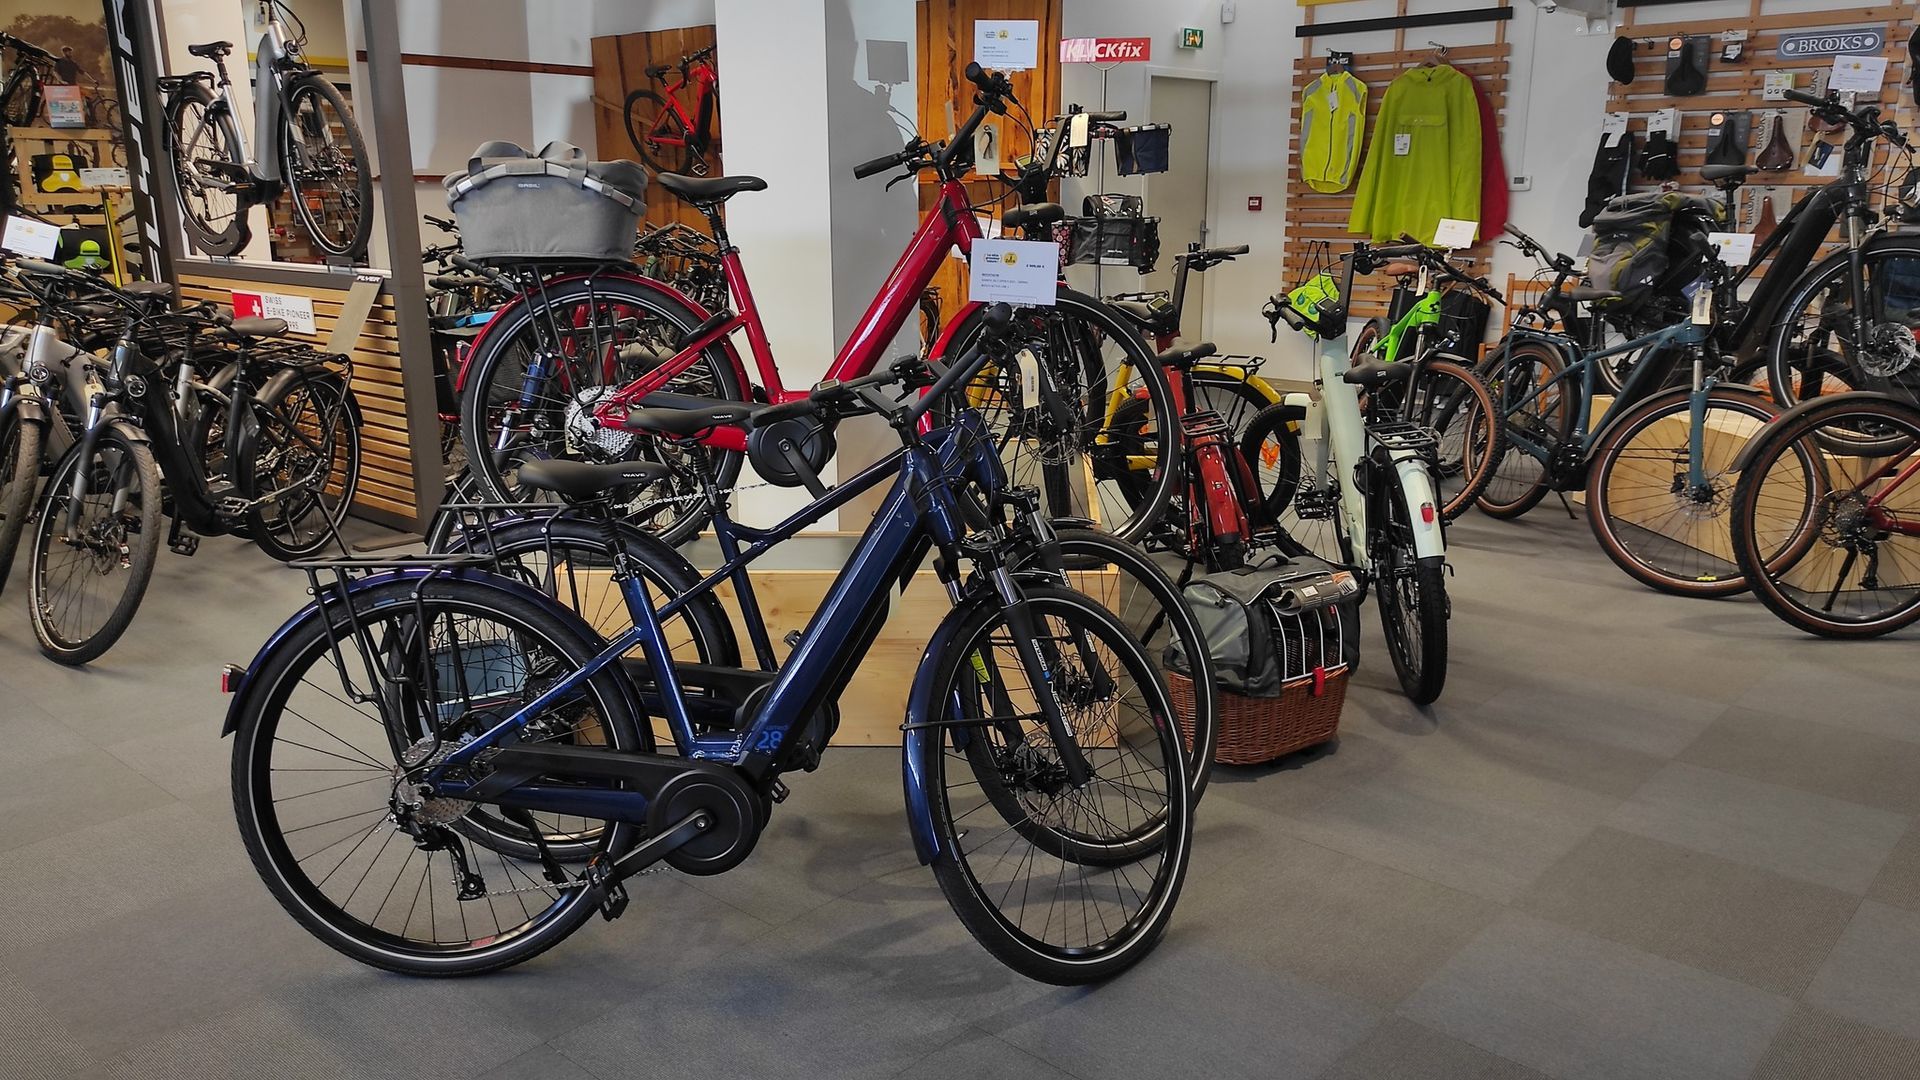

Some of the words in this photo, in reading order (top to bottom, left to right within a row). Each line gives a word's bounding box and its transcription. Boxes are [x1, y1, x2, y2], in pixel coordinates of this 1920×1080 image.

[1798, 36, 1862, 53] BROOKS
[1746, 188, 1756, 225] BROOKS
[265, 295, 282, 305] SWISS
[266, 306, 285, 318] E-BIKE
[286, 309, 310, 320] PIONEER
[757, 731, 782, 749] 28
